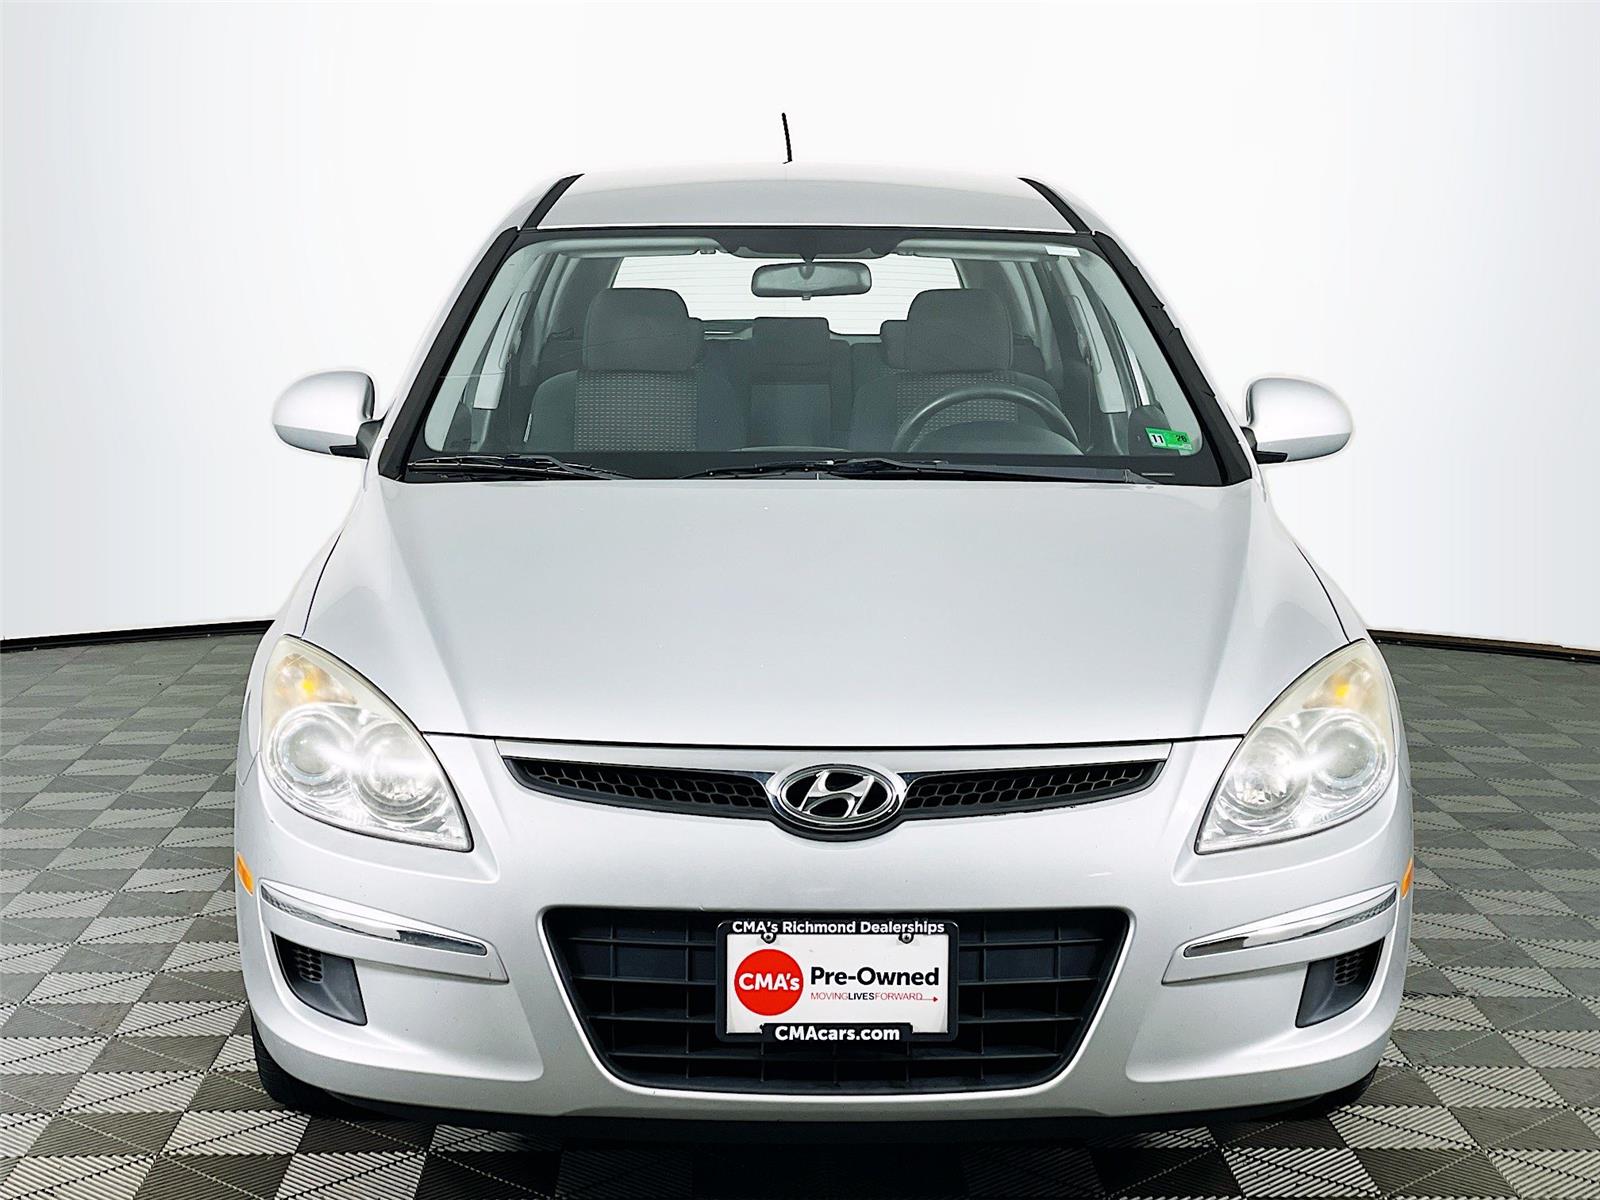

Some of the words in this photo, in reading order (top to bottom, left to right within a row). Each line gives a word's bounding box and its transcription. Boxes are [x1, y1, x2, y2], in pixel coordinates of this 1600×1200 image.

[1151, 434, 1164, 444] 11
[732, 920, 778, 933] CMA's
[782, 920, 856, 933] Richmond
[860, 920, 945, 934] Dealerships
[738, 973, 800, 991] CMA's
[811, 967, 940, 986] Pre-Owned
[775, 1026, 900, 1041] CMAcars.com
